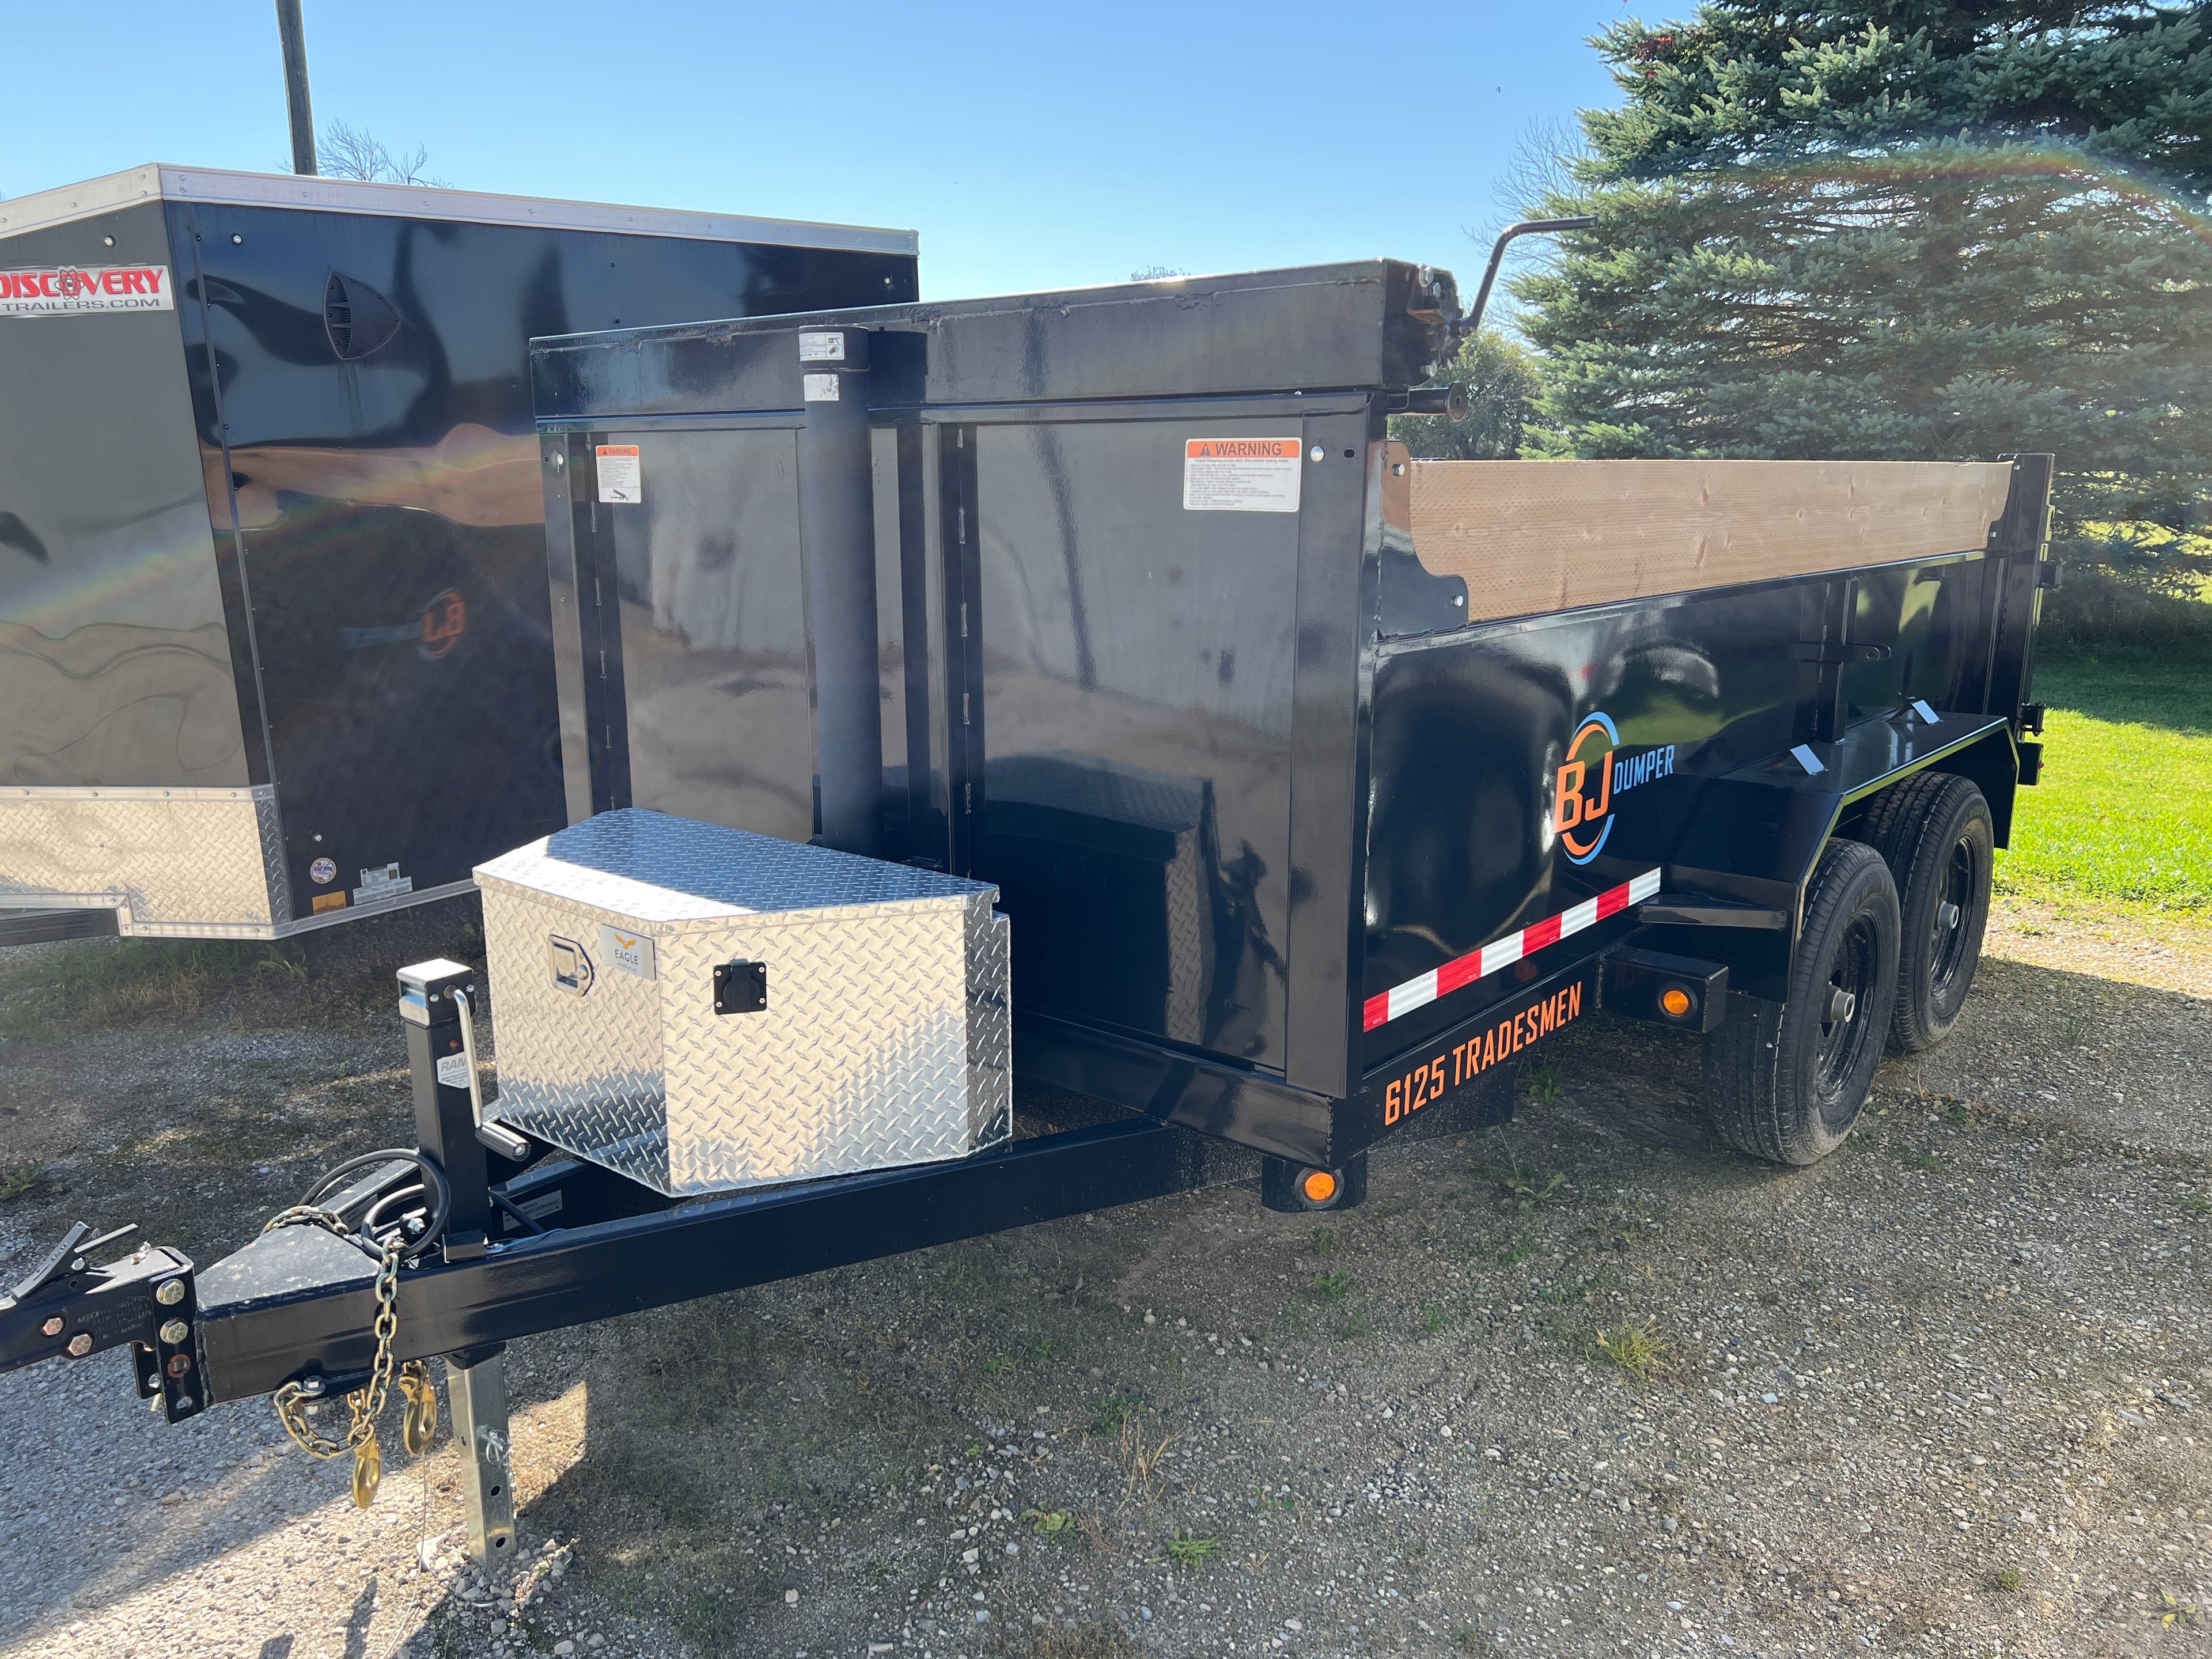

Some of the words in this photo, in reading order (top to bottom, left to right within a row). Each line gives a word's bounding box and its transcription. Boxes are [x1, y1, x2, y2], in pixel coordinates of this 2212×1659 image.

[0, 268, 162, 298] DISCOVERY
[2, 298, 160, 312] TRAILERS.COM
[1215, 442, 1282, 456] WARNING
[1553, 751, 1613, 834] BJ
[1613, 745, 1675, 795] DUMPER
[615, 949, 639, 965] EAGLE
[1385, 1054, 1445, 1126] 6125
[1452, 981, 1582, 1086] TRADESMEN
